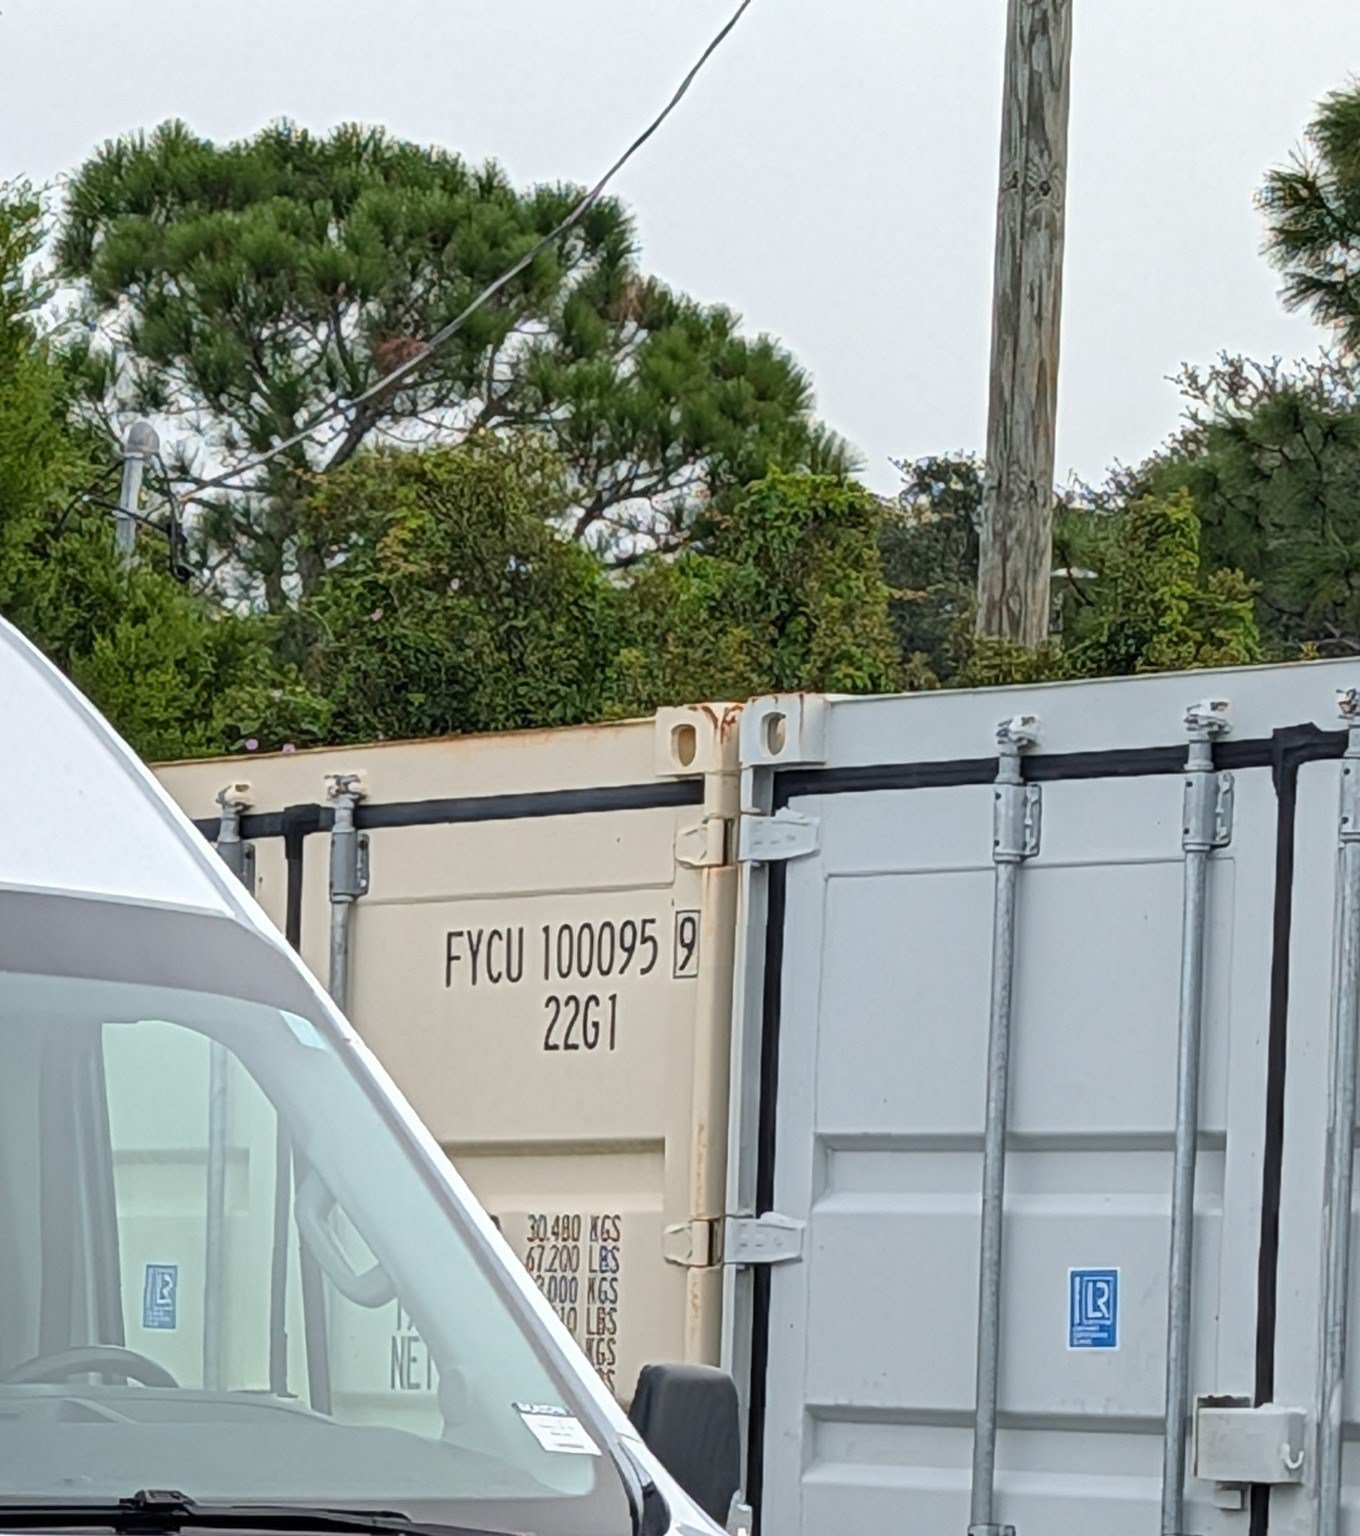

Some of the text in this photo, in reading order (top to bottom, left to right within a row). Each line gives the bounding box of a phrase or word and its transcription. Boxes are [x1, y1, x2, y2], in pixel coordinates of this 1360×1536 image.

[445, 913, 698, 988] FYCU 100095 9
[543, 993, 618, 1052] 22G1
[527, 1213, 582, 1242] 30.480
[588, 1213, 622, 1243] KGS
[588, 1244, 620, 1275] LBS
[586, 1276, 619, 1305] KGS
[1085, 1280, 1111, 1319] LR
[586, 1306, 618, 1336] LBS
